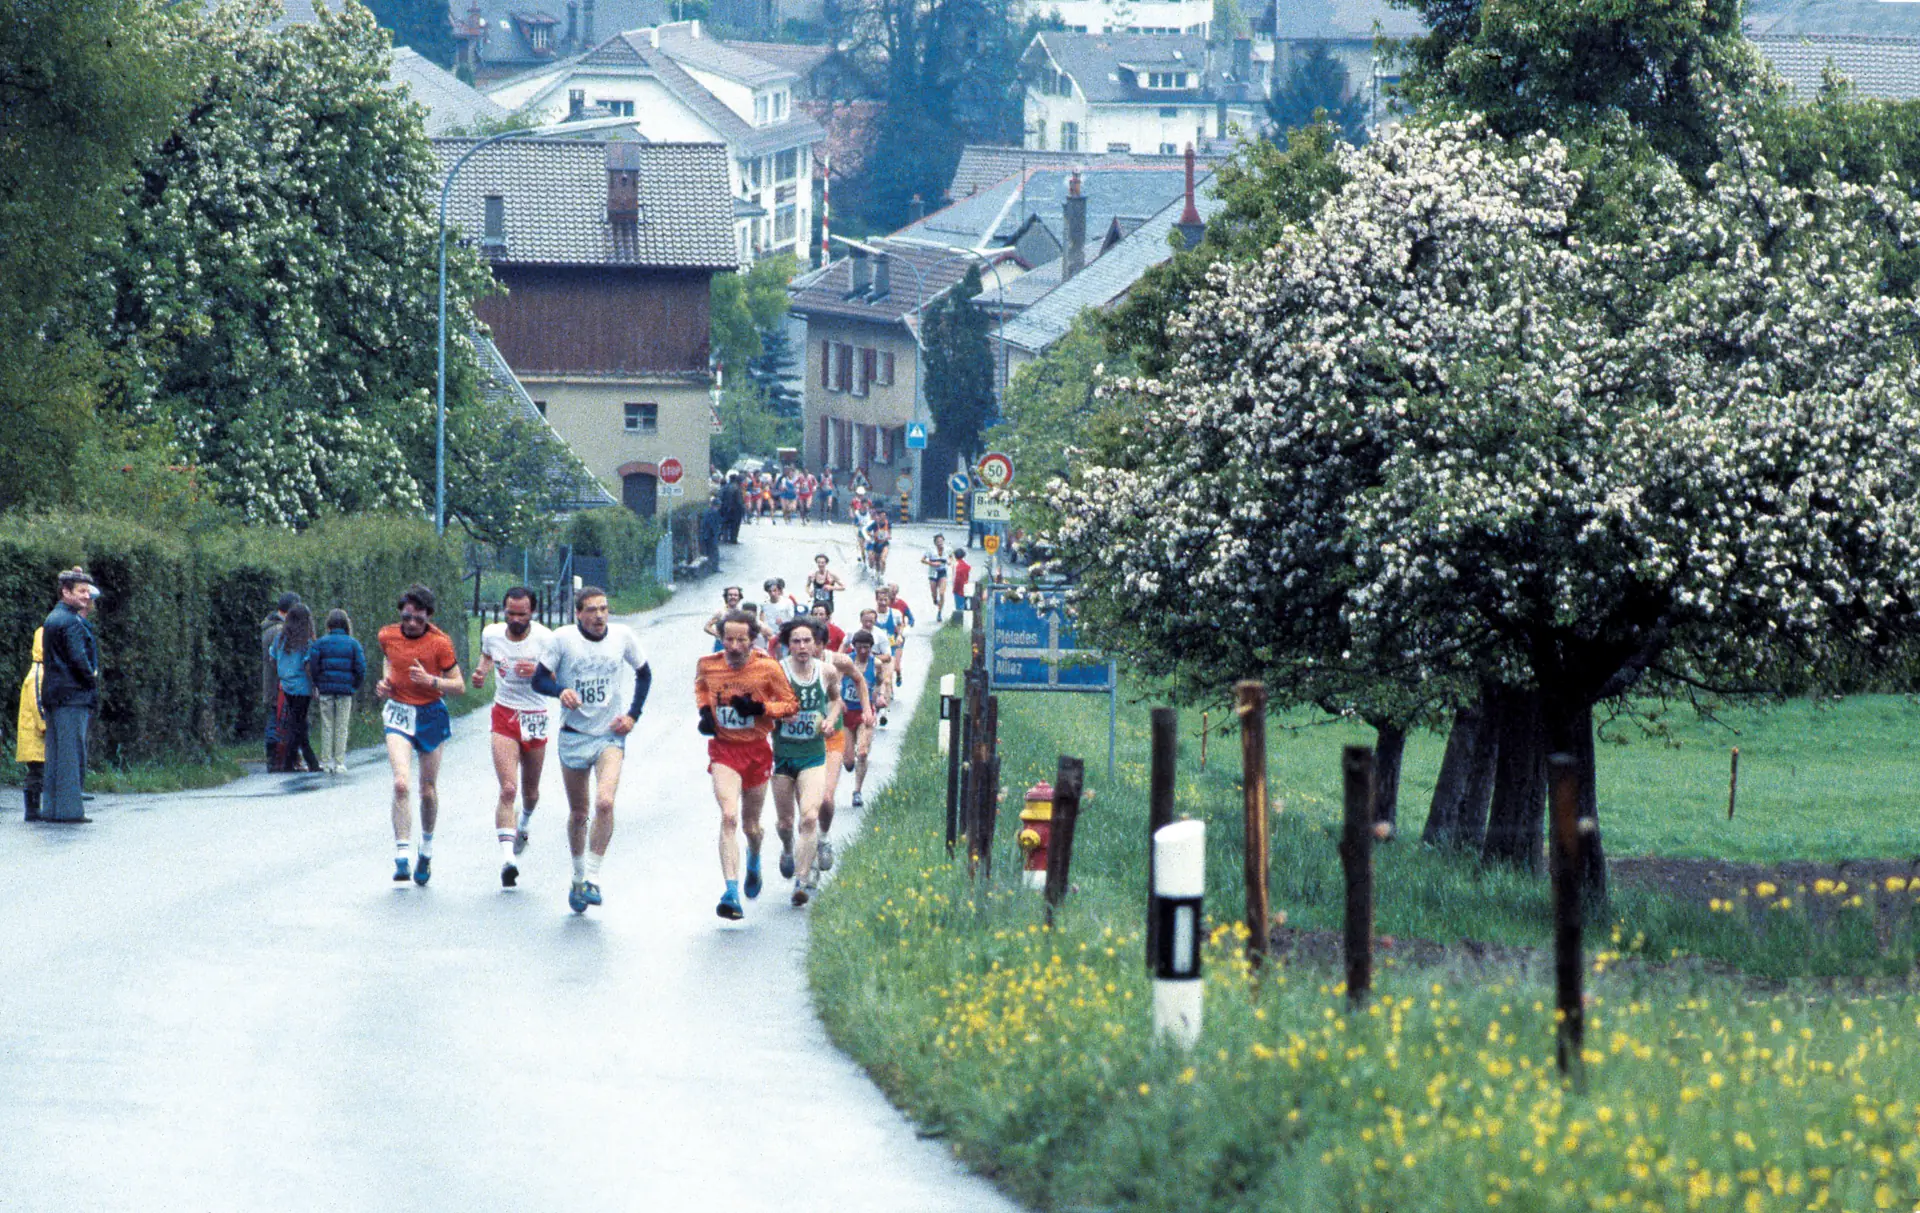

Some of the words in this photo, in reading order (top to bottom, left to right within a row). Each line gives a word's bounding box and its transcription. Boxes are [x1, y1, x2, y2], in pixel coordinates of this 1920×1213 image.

[661, 465, 681, 476] STOP
[987, 464, 1003, 478] 50
[580, 685, 606, 704] 185
